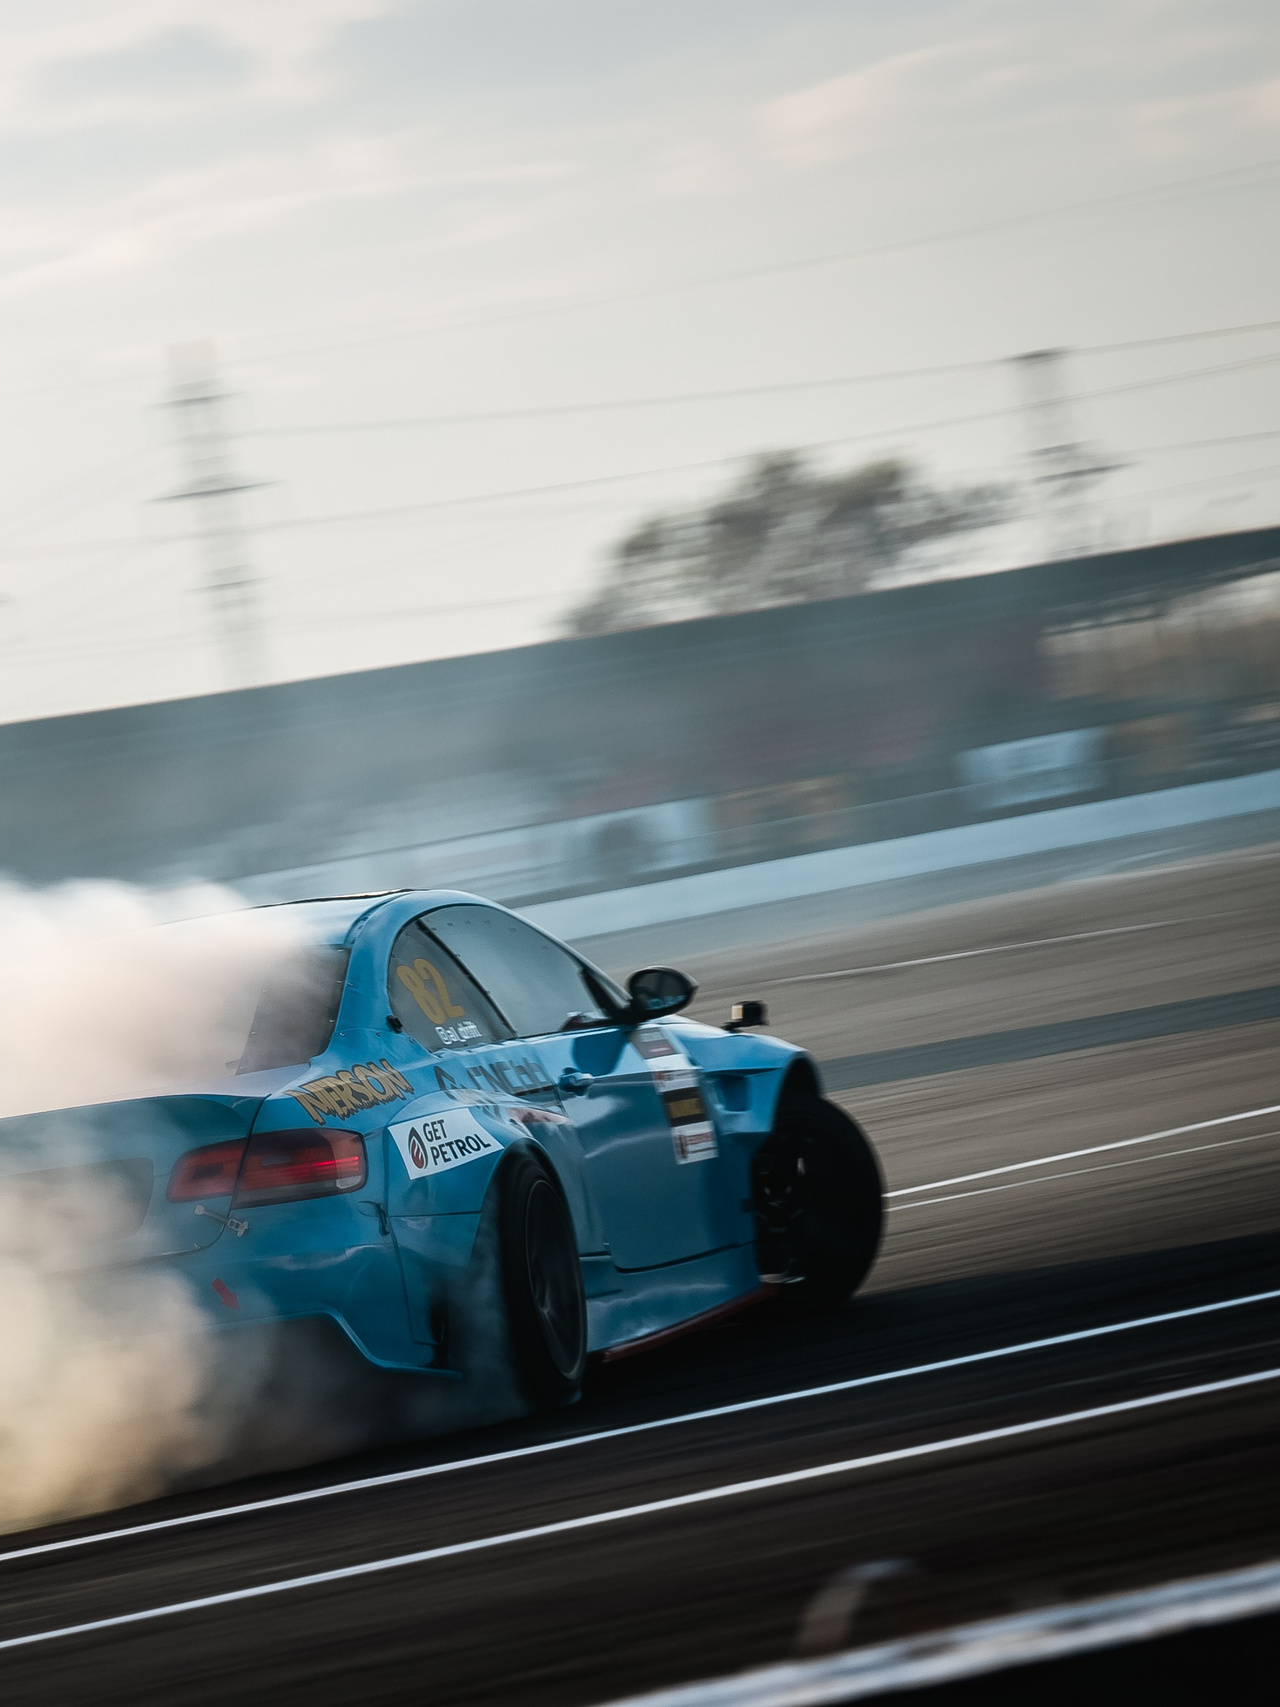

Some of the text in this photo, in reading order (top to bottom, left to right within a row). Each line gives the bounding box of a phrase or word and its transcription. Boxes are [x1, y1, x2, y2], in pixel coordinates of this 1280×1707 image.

[396, 958, 466, 1025] 82
[423, 1119, 447, 1142] GET
[430, 1134, 491, 1166] PETROL
